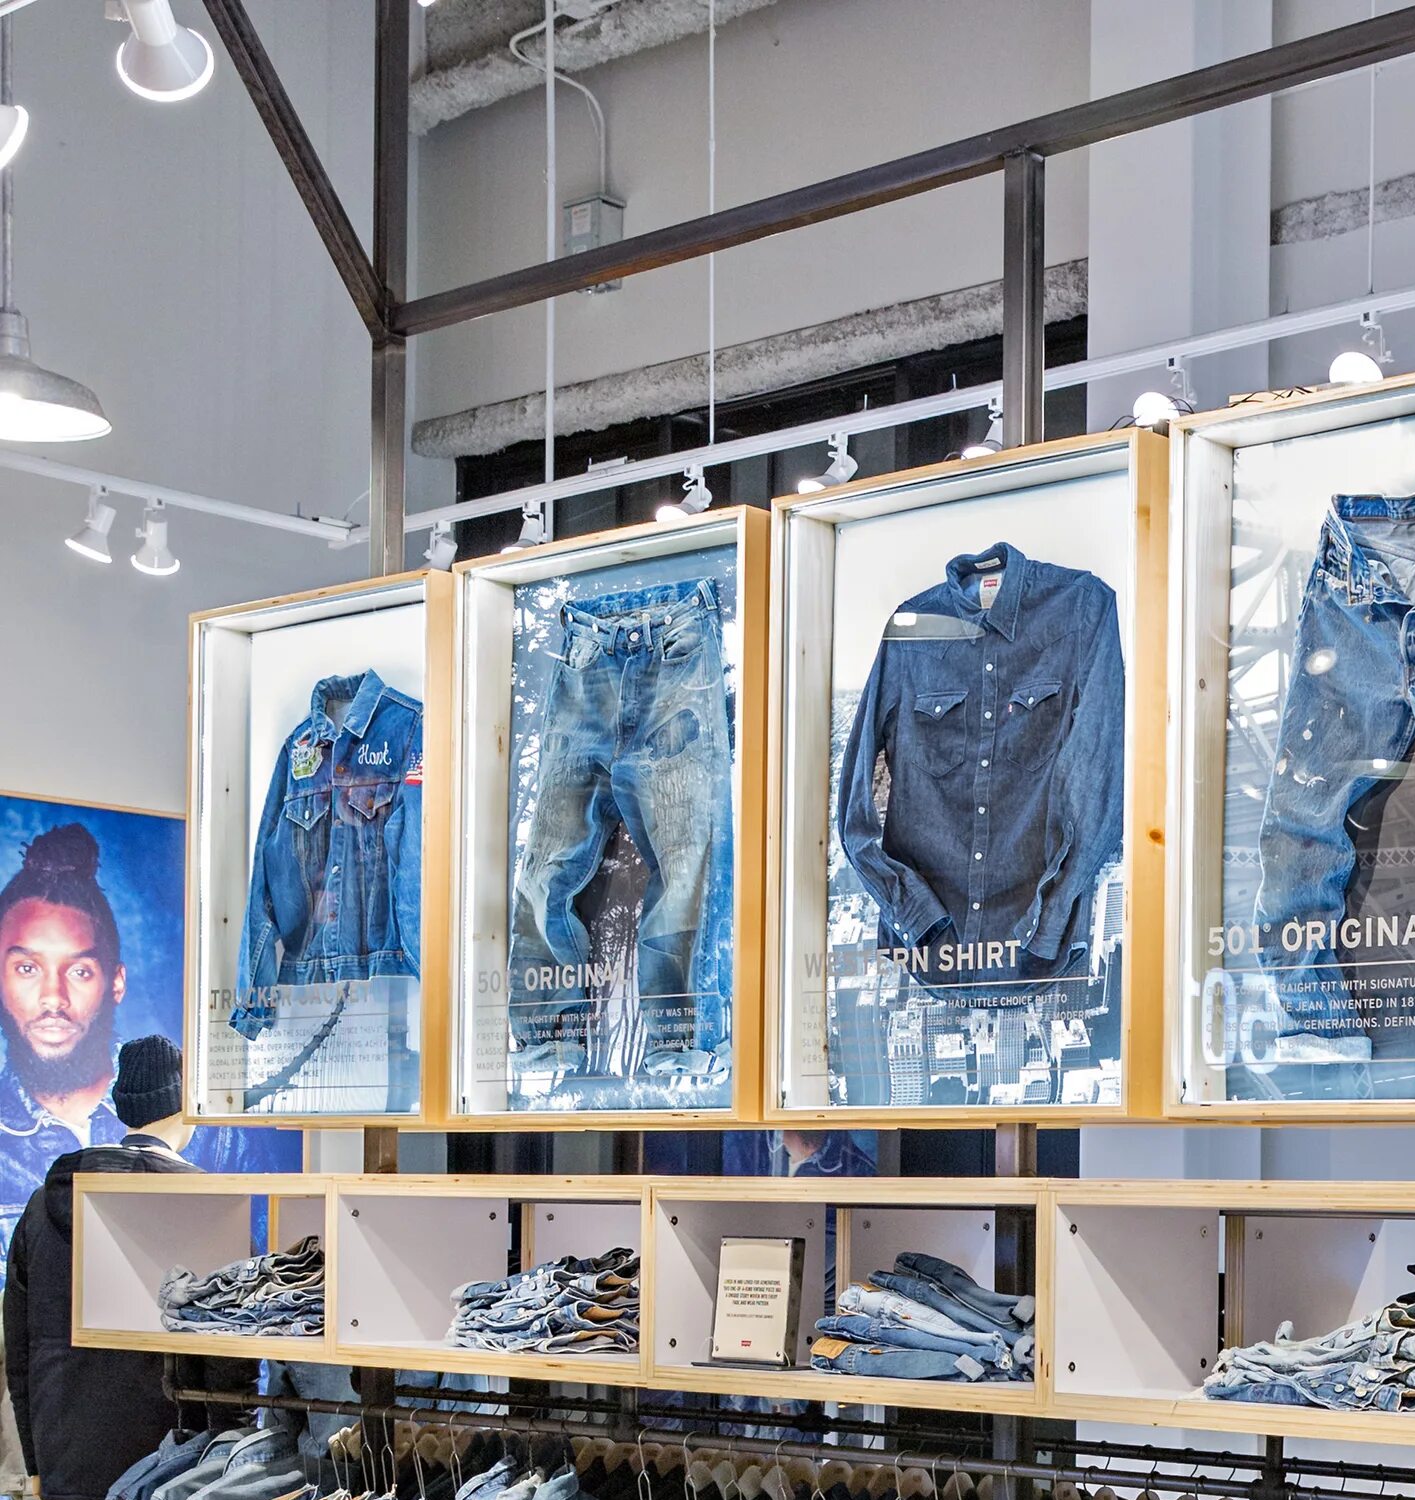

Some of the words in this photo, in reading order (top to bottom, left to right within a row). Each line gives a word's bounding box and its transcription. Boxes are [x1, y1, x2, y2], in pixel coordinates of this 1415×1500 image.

[938, 940, 1021, 972] SHIRT
[524, 961, 628, 991] ORIGINAL
[1321, 981, 1337, 992] FIT
[1340, 980, 1367, 991] WITH
[211, 986, 291, 1010] TRUCKER
[948, 999, 966, 1008] HAD
[969, 997, 998, 1007] LITTLE
[1001, 996, 1032, 1006] CHOICE
[1055, 994, 1067, 1003] TO
[1295, 1000, 1326, 1012] JEAN.
[1329, 998, 1382, 1010] INVENTED
[1386, 998, 1397, 1008] IN
[562, 1013, 579, 1022] WITH
[1304, 1017, 1380, 1030] GENERATIONS.
